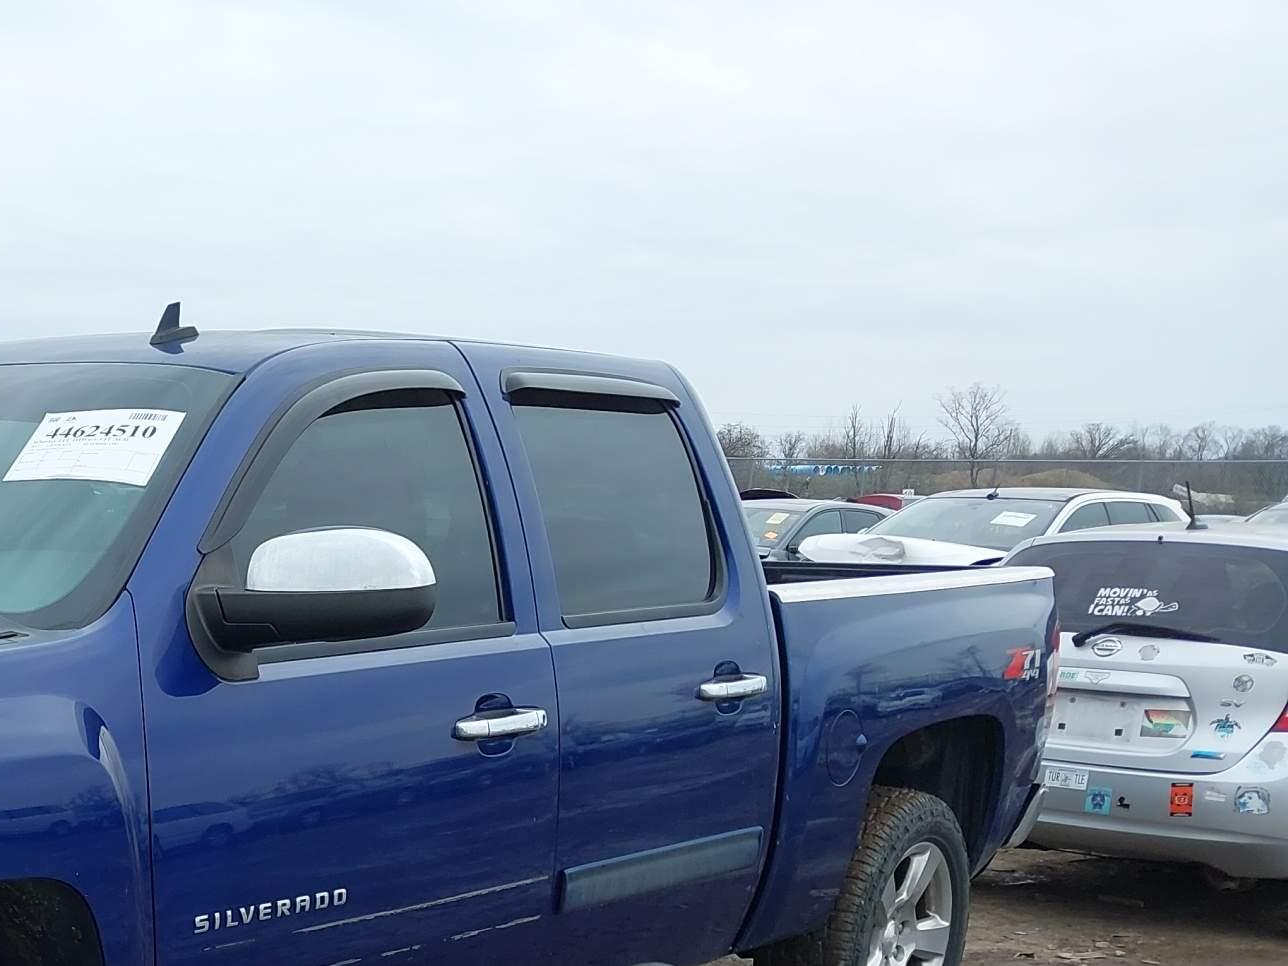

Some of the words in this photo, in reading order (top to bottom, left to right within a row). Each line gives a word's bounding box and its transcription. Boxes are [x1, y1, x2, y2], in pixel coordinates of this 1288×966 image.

[46, 424, 158, 439] 44624510
[1097, 587, 1147, 597] MOVIN'
[1094, 597, 1120, 605] FAST
[1093, 605, 1129, 616] CAN!
[1048, 771, 1061, 782] TUR
[1074, 774, 1087, 785] TLE
[194, 888, 347, 934] SILVERADO
